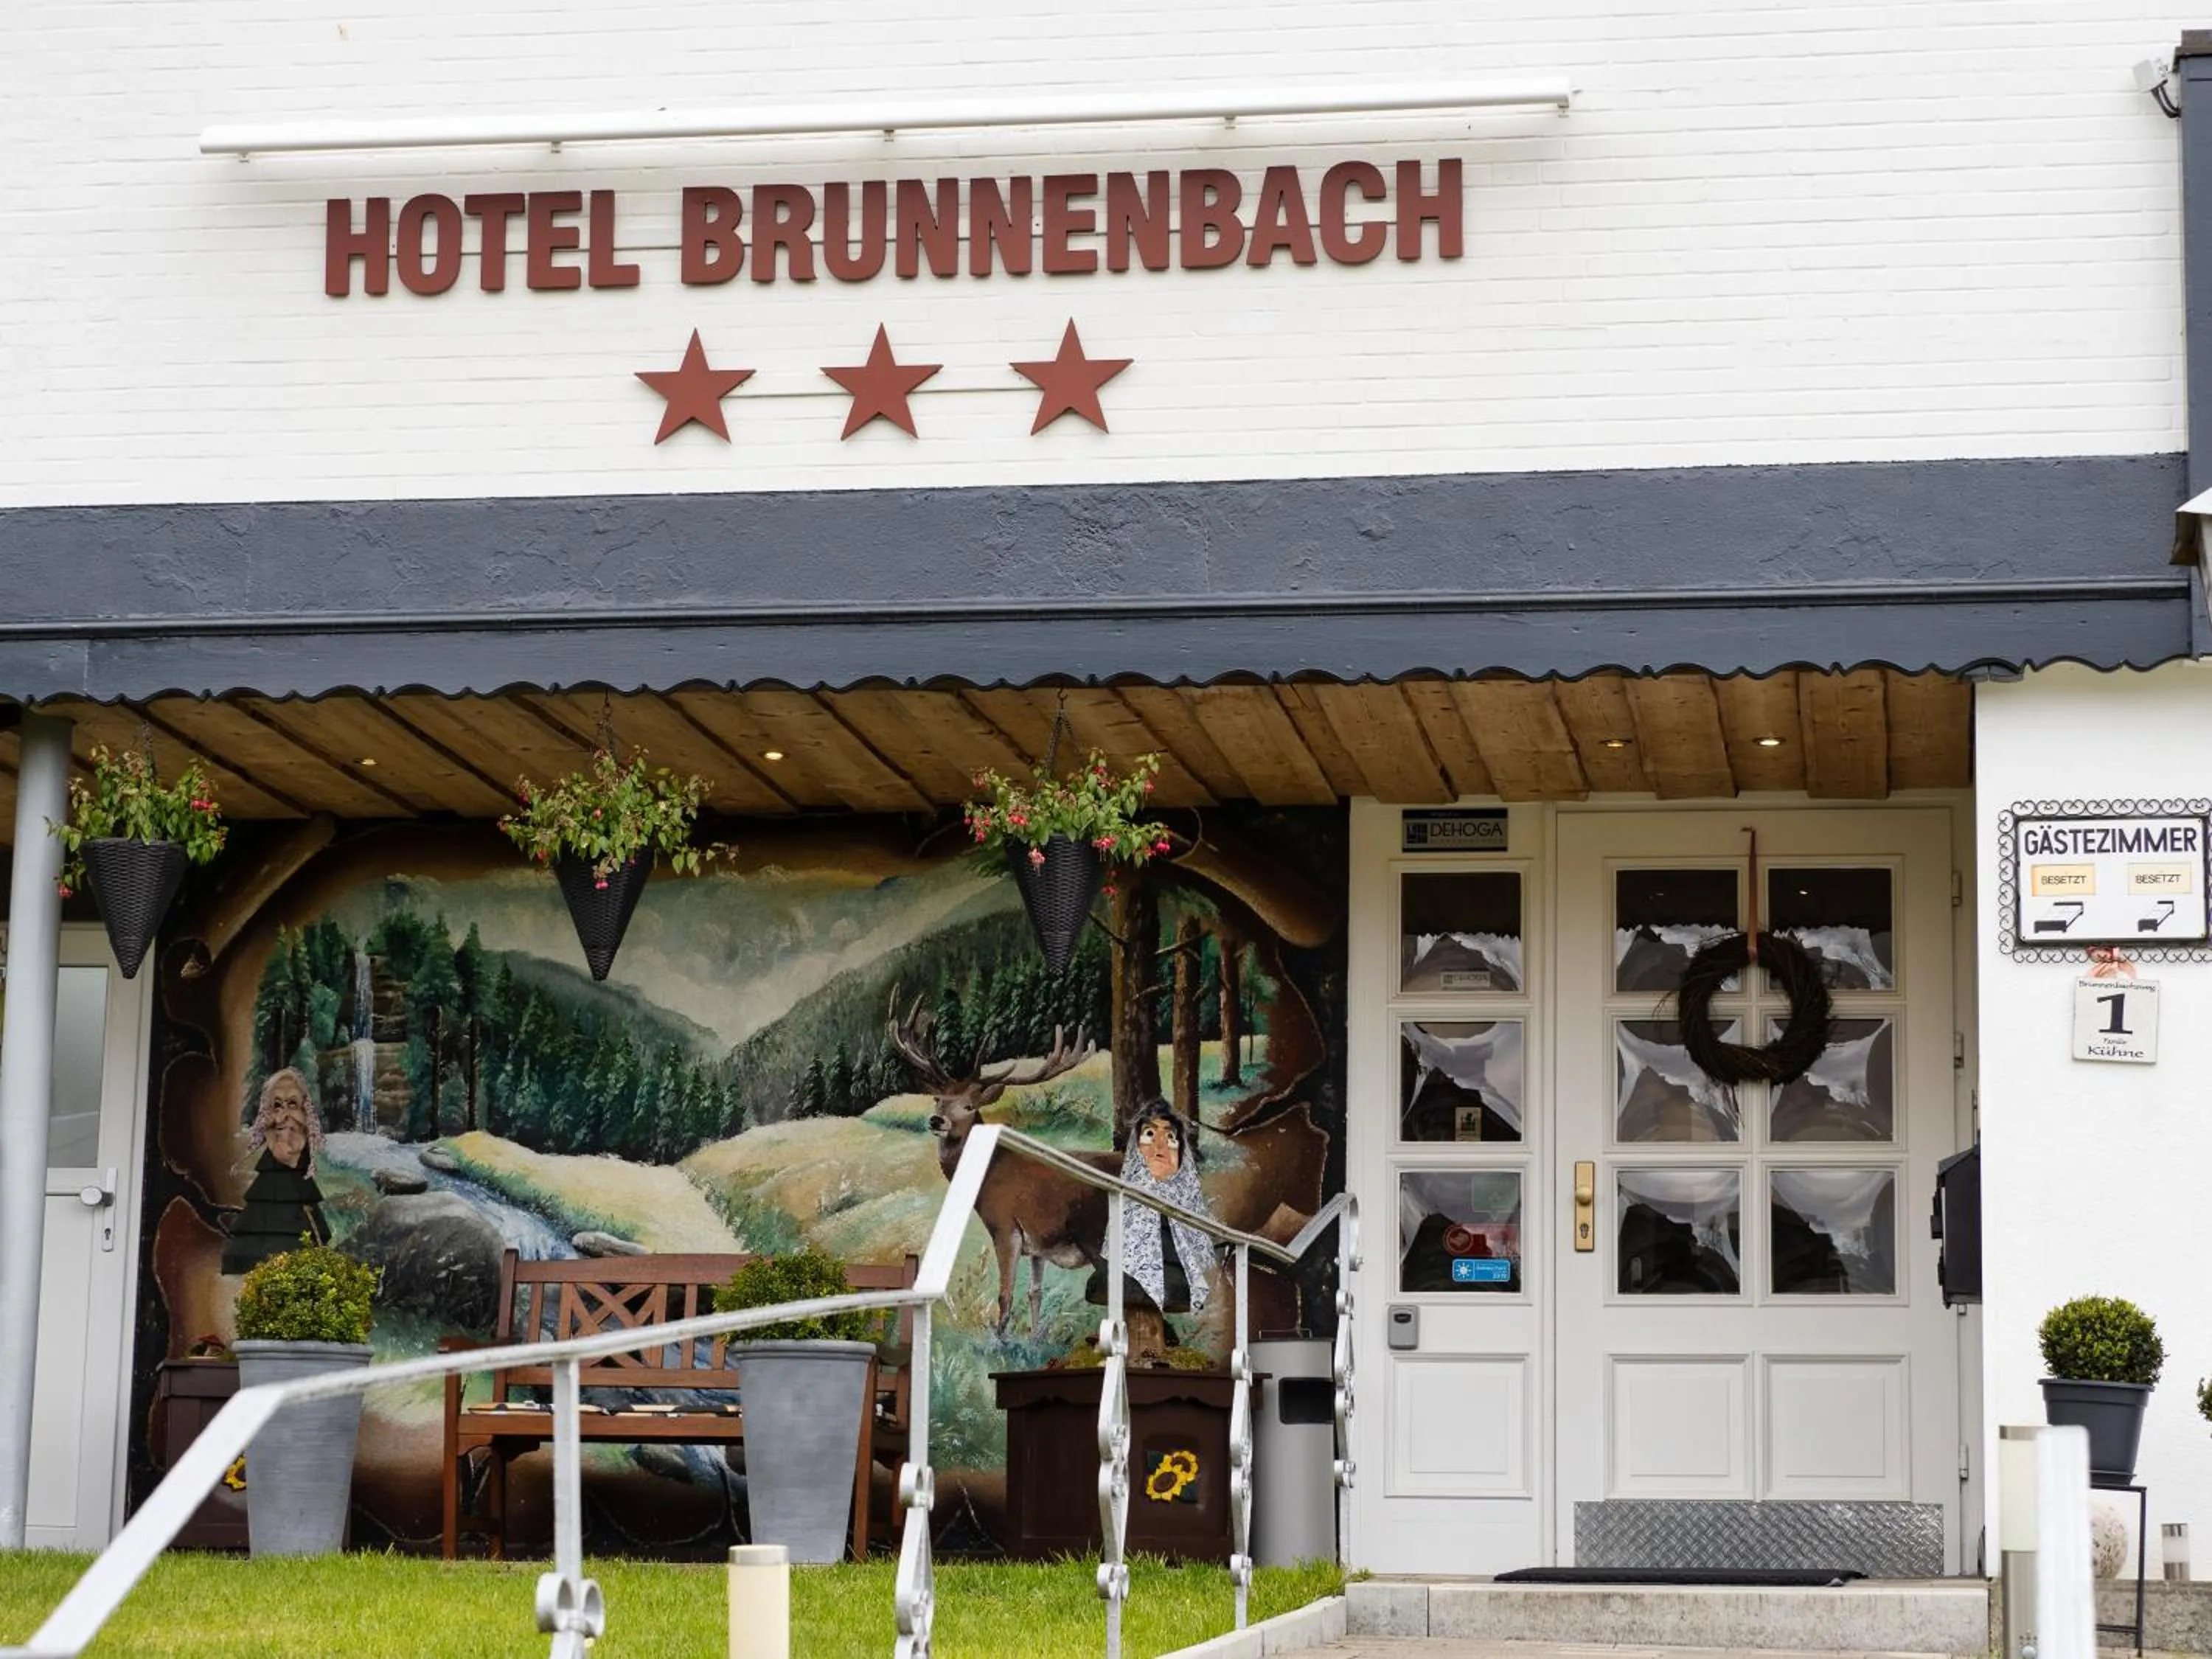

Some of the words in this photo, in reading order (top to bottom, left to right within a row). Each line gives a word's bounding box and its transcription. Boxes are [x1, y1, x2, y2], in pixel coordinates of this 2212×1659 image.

[324, 189, 640, 297] HOTEL
[681, 157, 1464, 286] BRUNNENBACH
[1430, 821, 1503, 838] DEHOGA
[2024, 824, 2197, 855] GÄSTEZIMMER
[2040, 875, 2087, 885] BESETZT
[2135, 874, 2182, 884] BESETZT
[2096, 992, 2133, 1034] 1
